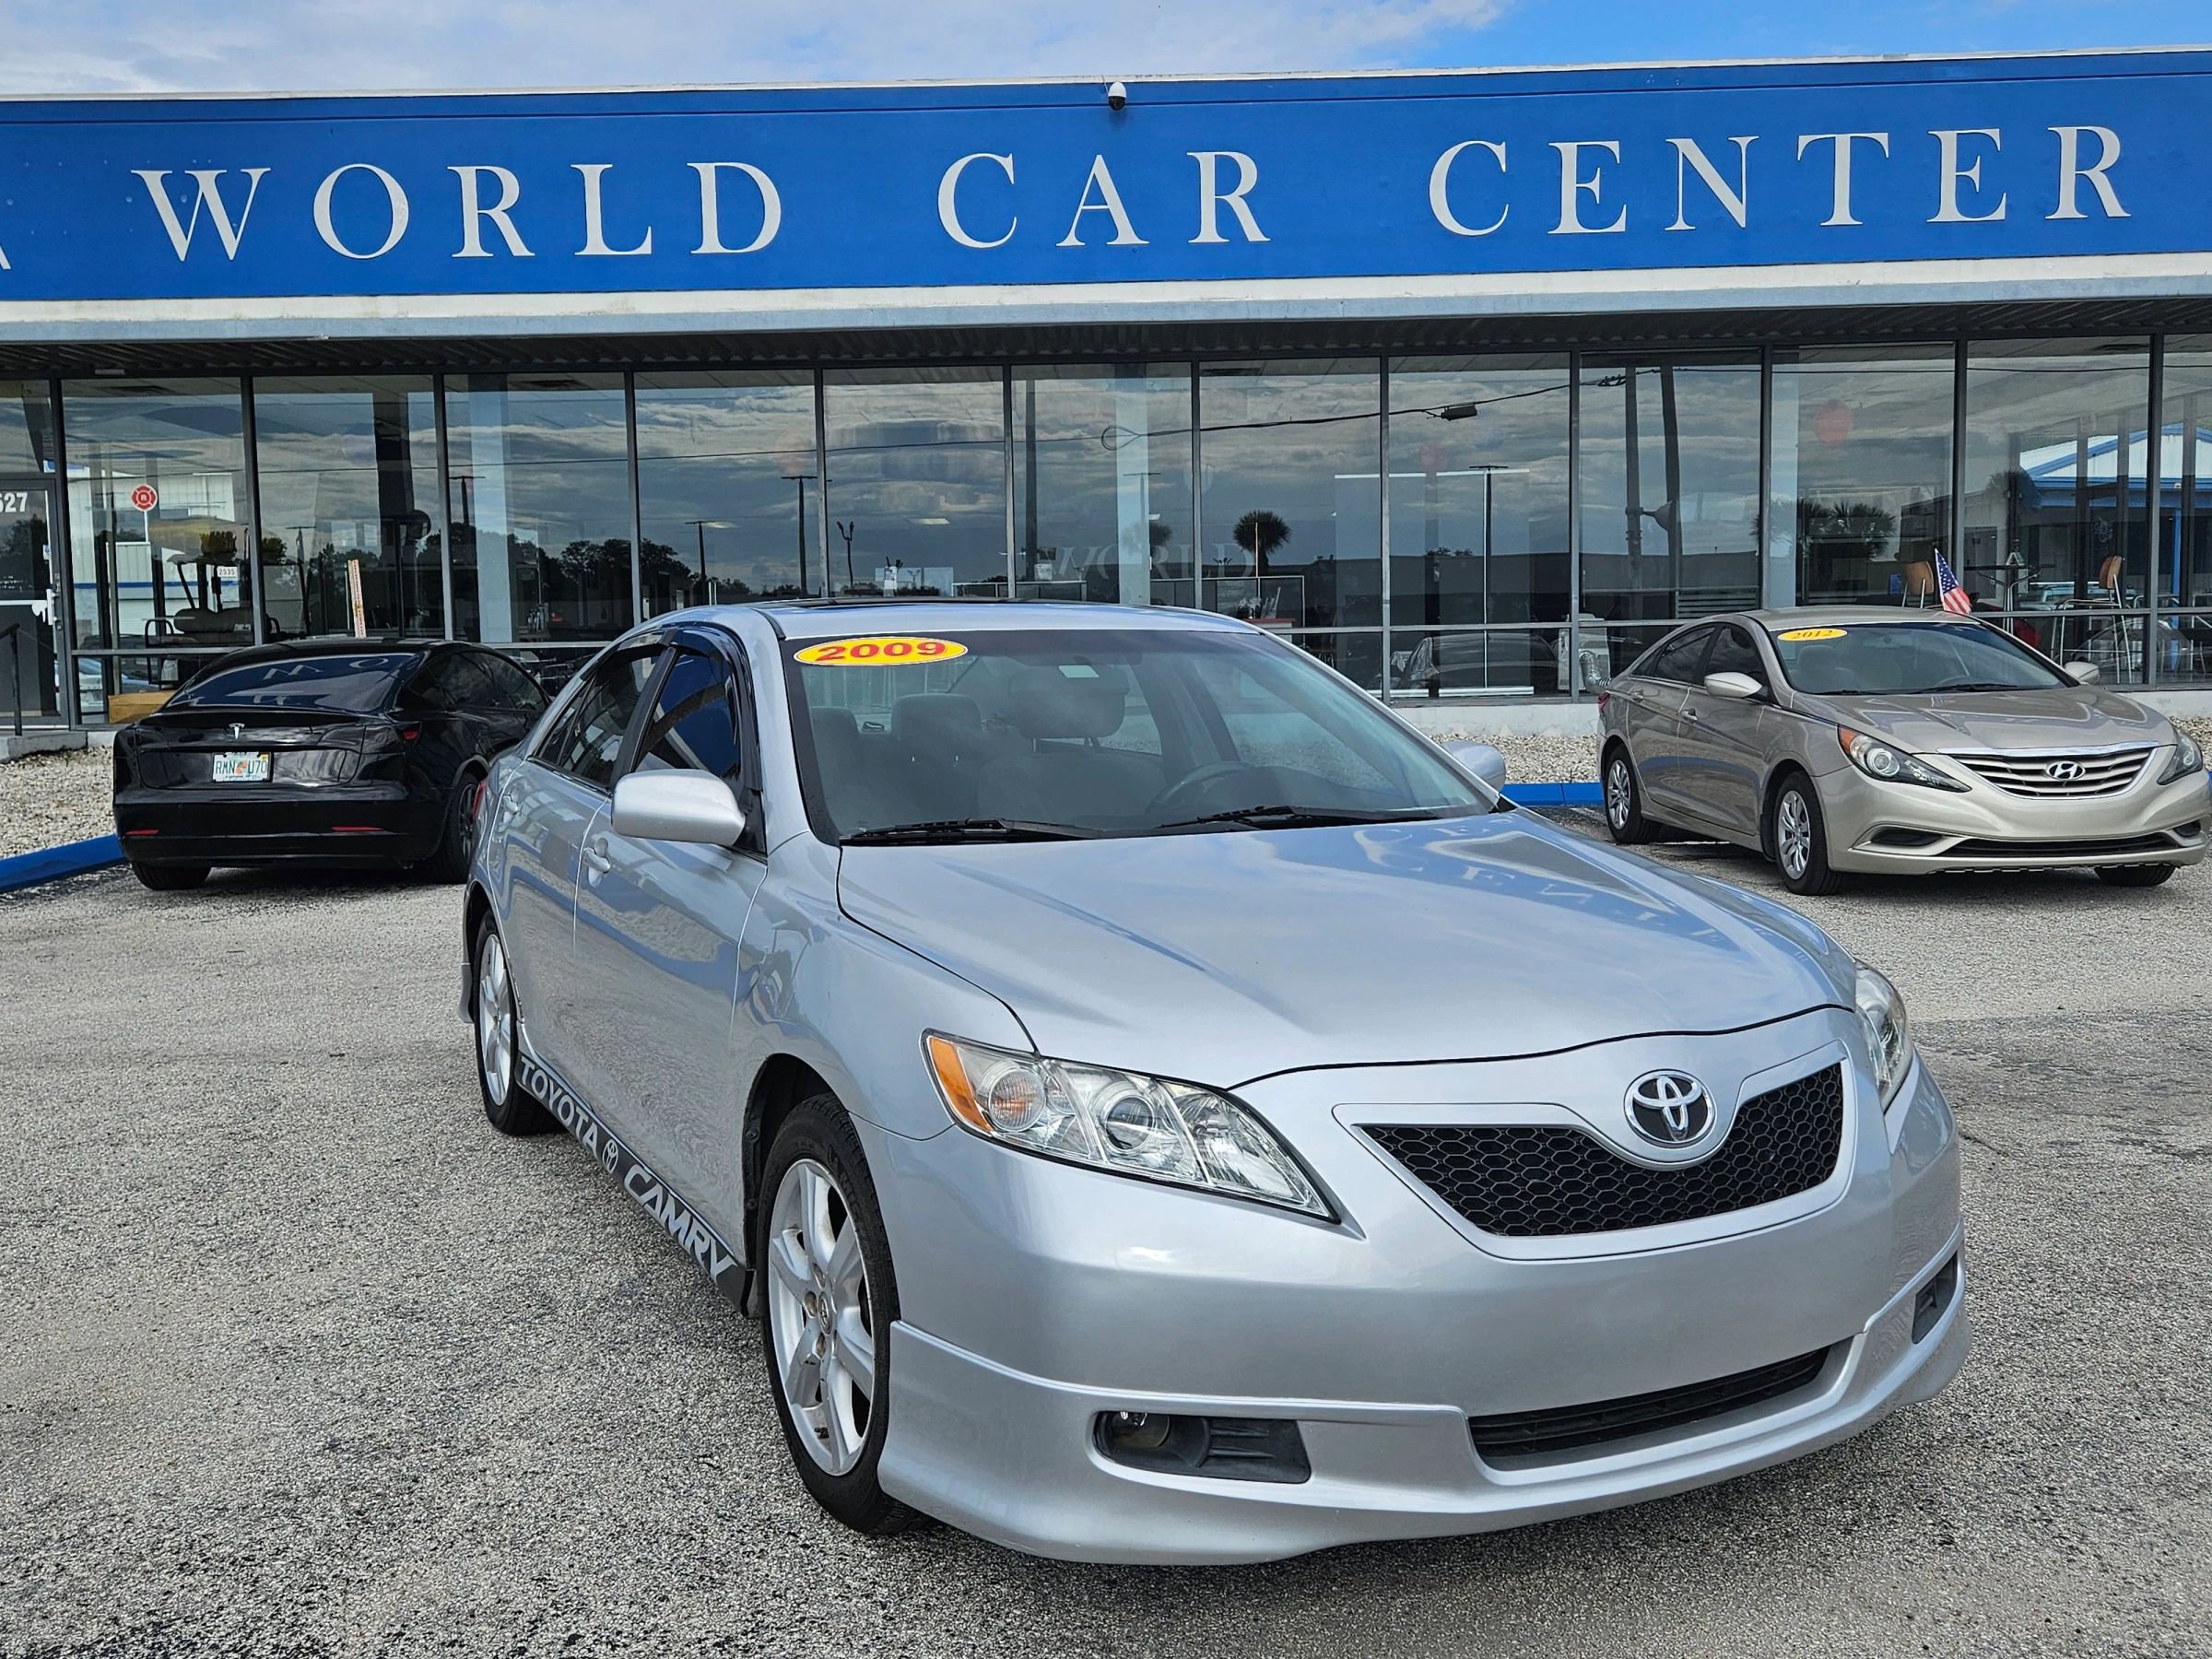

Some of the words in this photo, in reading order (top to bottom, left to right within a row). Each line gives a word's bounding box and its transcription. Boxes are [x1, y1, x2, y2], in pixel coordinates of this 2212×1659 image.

[132, 162, 781, 262] WORLD
[938, 150, 1270, 249] CAR
[1430, 126, 2131, 236] CENTER
[815, 641, 947, 662] 2009
[1792, 630, 1833, 639] 2012
[521, 1055, 598, 1160] TOYOTA
[624, 1164, 738, 1283] CAMRY
